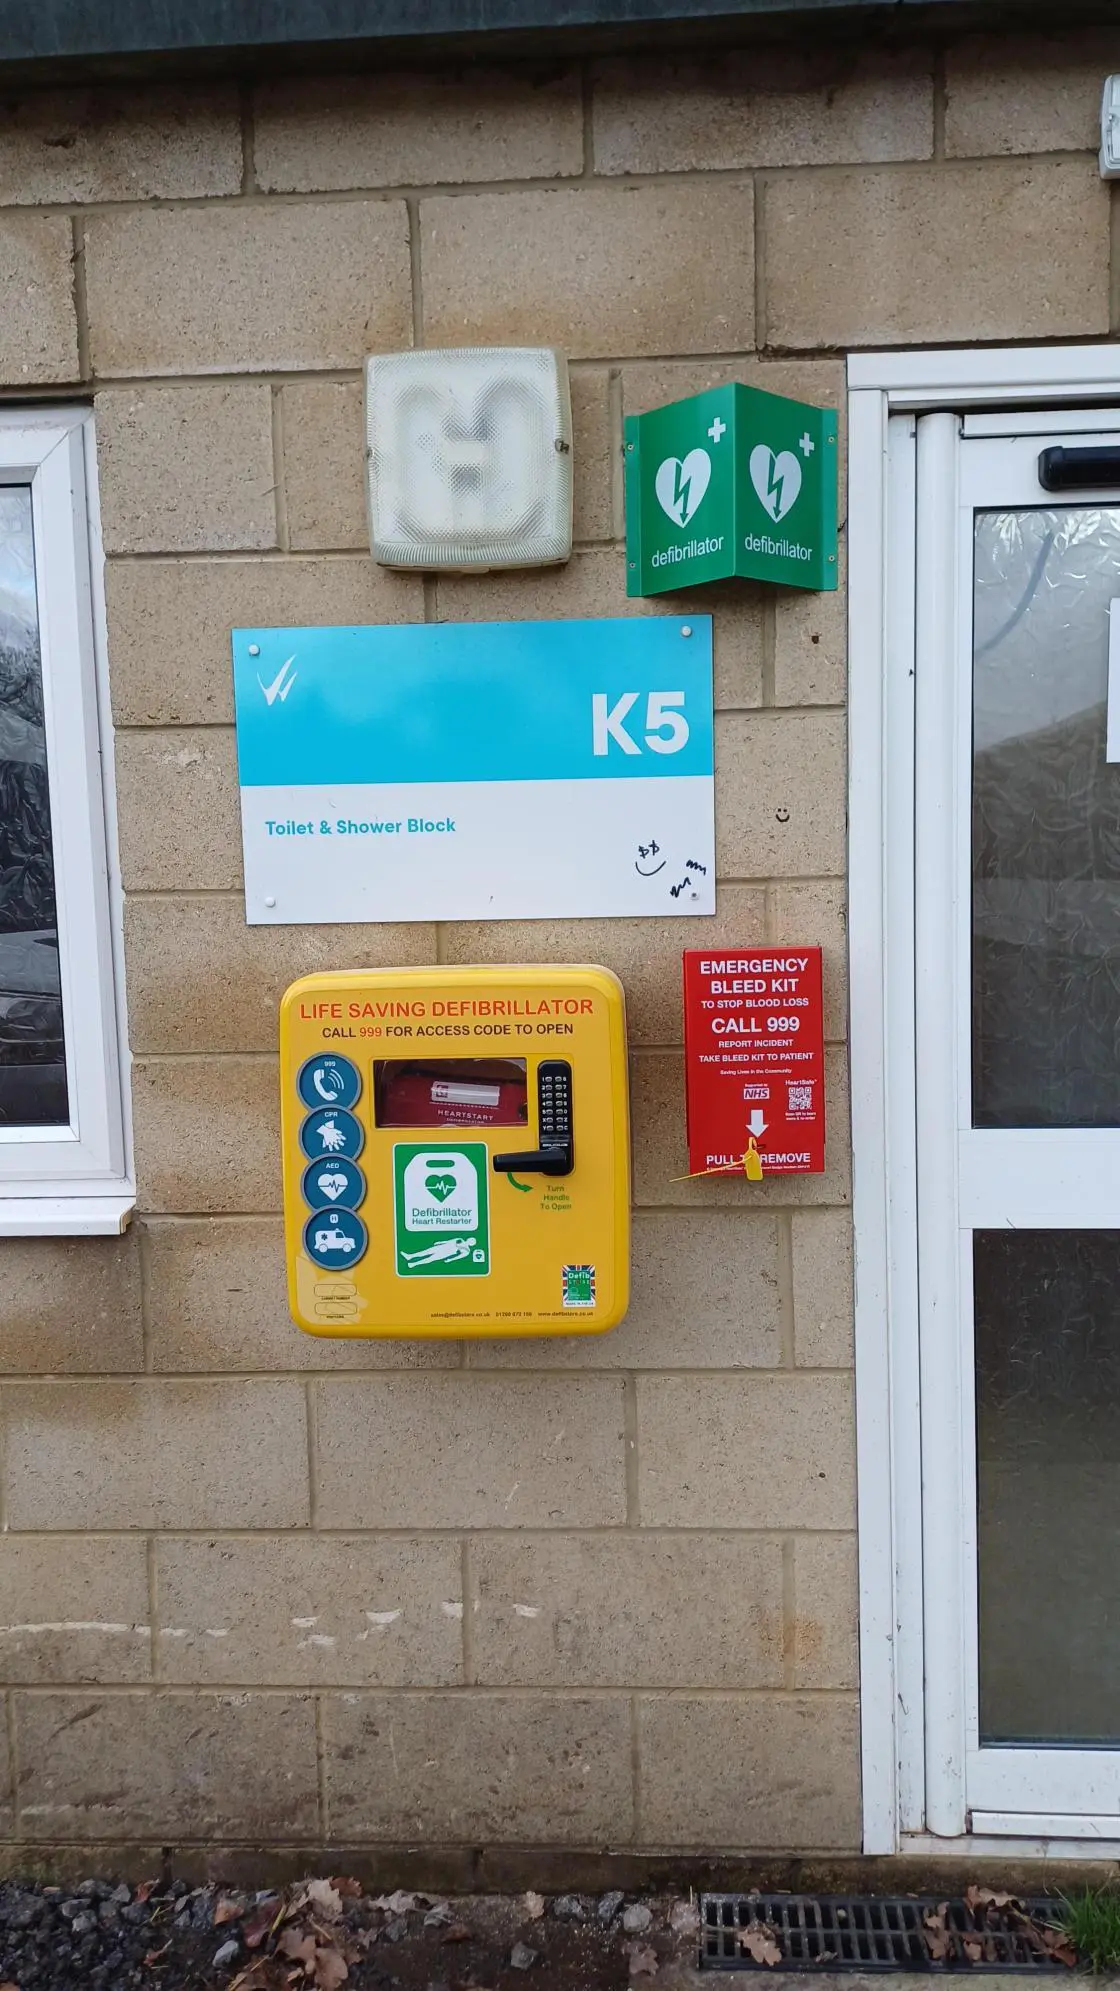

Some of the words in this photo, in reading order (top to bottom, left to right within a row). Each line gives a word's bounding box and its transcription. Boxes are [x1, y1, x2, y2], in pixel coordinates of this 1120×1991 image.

[651, 536, 724, 567] defibrillator
[744, 533, 812, 561] defibrillator
[592, 691, 690, 756] K5
[265, 820, 314, 835] Toilet
[319, 820, 332, 834] &
[336, 819, 402, 834] Shower
[407, 818, 456, 832] Block
[700, 958, 808, 975] EMERGENCY
[711, 979, 767, 994] BLEED
[771, 978, 799, 993] KIT
[300, 1003, 343, 1019] LIFE
[348, 1001, 426, 1018] SAVING
[432, 999, 594, 1017] DEFIBRILLATOR
[701, 1000, 715, 1008] TO
[717, 1000, 743, 1008] STOP
[745, 999, 780, 1007] BLOOD
[783, 998, 809, 1007] LOSS
[322, 1027, 356, 1038] CALL
[360, 1026, 382, 1038] 999
[386, 1026, 413, 1037] FOR
[416, 1025, 470, 1036] ACCESS
[473, 1024, 511, 1036] CODE
[515, 1024, 533, 1035] TO
[536, 1023, 574, 1035] OPEN
[711, 1018, 762, 1034] CALL
[767, 1016, 800, 1032] 999
[718, 1040, 752, 1048] REPORT
[754, 1039, 794, 1047] INCIDENT
[699, 1054, 720, 1063] TAKE
[722, 1054, 749, 1062] BLEED
[751, 1053, 765, 1061] KIT
[767, 1053, 778, 1061] TO
[780, 1052, 814, 1060] PATIENT
[744, 1089, 768, 1098] NHS
[437, 1109, 493, 1121] HEARTSTART
[706, 1154, 734, 1165] PULL
[760, 1153, 811, 1164] REMOVE
[546, 1184, 565, 1192] Turn
[543, 1193, 570, 1201] Handle
[412, 1207, 473, 1217] Defibrillator
[551, 1203, 572, 1211] Open
[412, 1217, 434, 1225] Heart
[435, 1217, 472, 1225] Restarter
[568, 1271, 590, 1279] Defib
